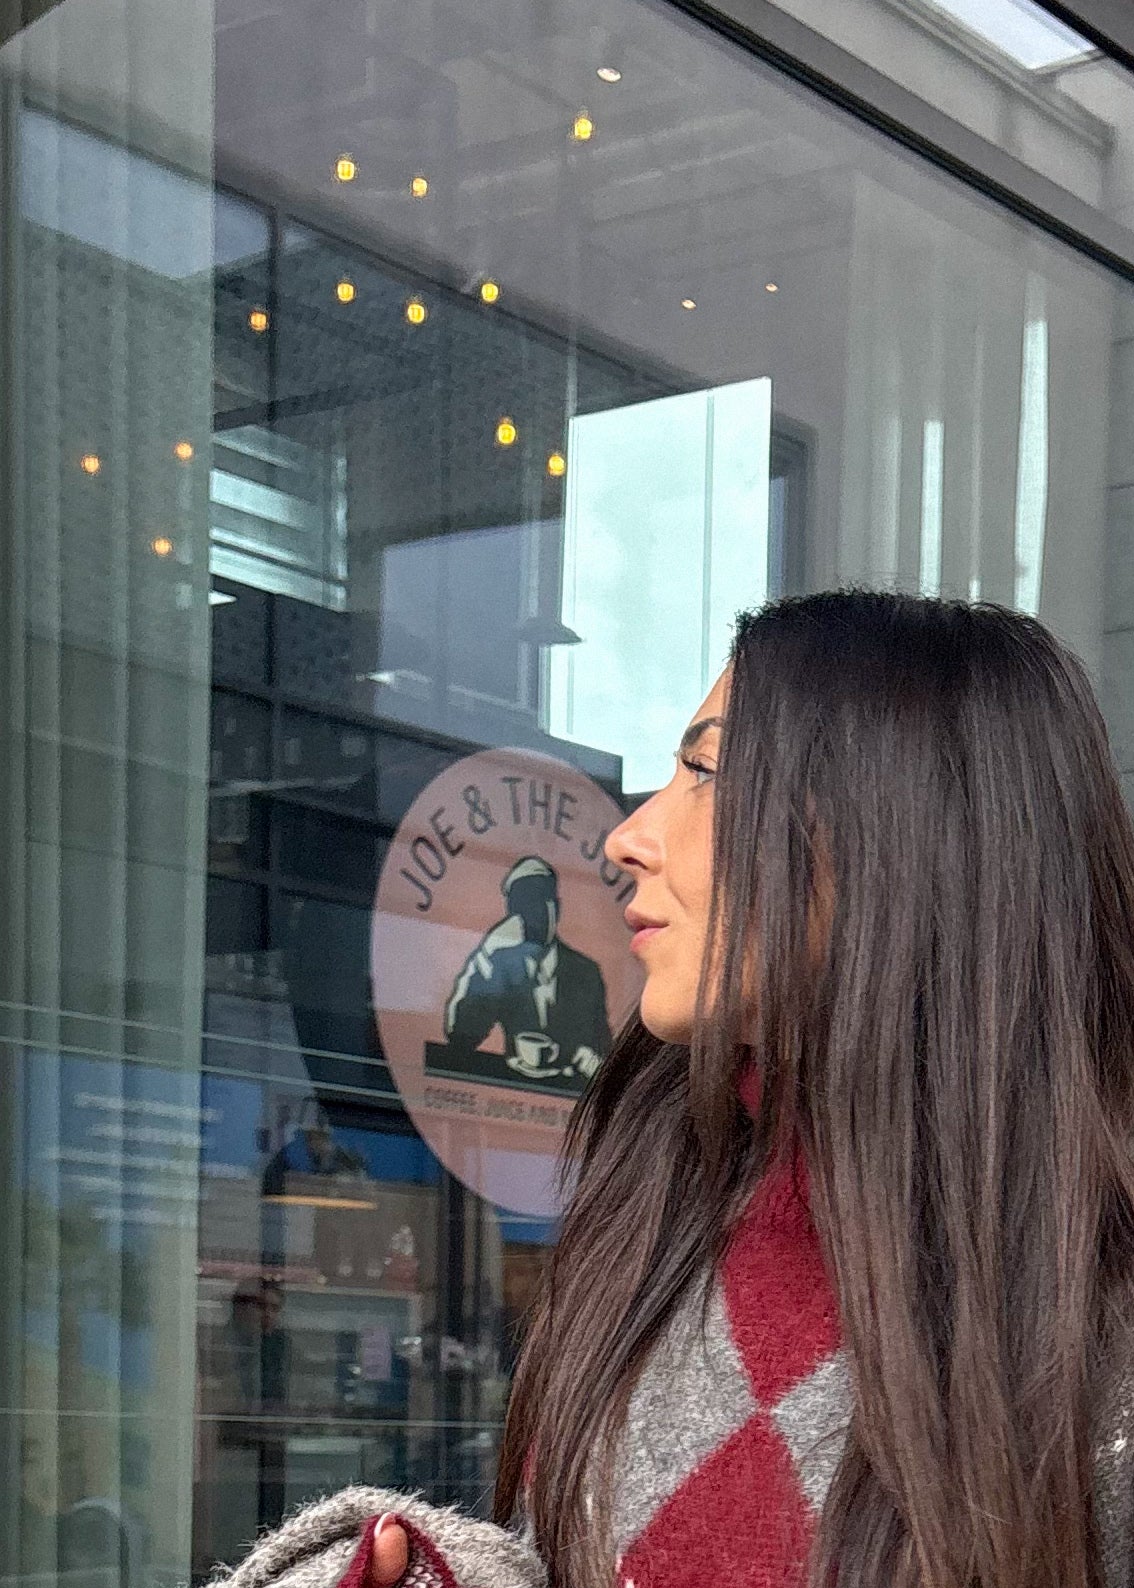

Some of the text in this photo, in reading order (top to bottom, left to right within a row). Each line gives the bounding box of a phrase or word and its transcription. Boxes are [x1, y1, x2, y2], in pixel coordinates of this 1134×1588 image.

[400, 806, 465, 912] JOE
[463, 784, 501, 834] &
[502, 776, 579, 842] THE
